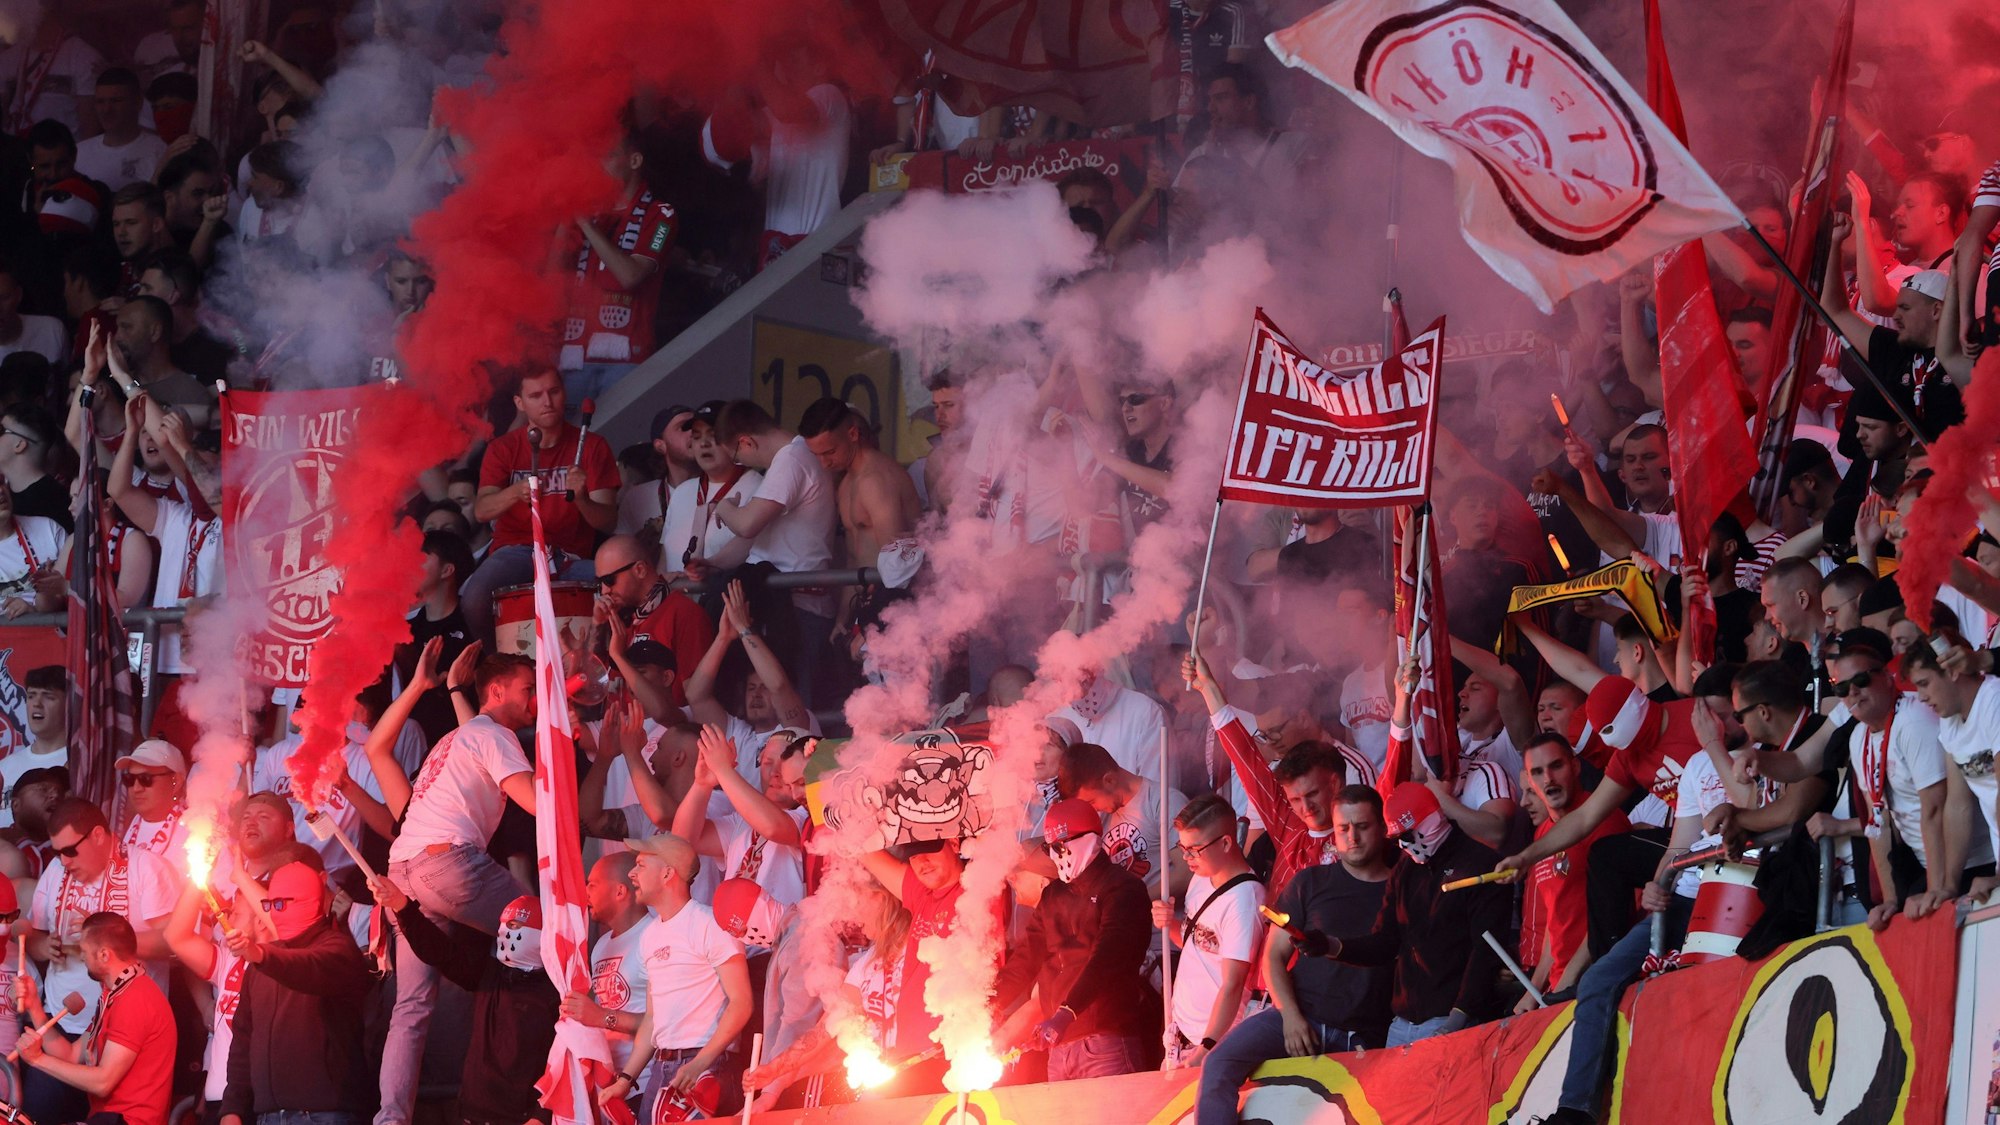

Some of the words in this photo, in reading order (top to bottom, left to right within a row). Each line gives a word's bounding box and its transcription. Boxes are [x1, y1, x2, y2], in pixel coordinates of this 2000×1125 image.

[651, 225, 669, 250] DEVK
[1236, 421, 1323, 486] 1.FC
[1320, 430, 1423, 488] KÖLN
